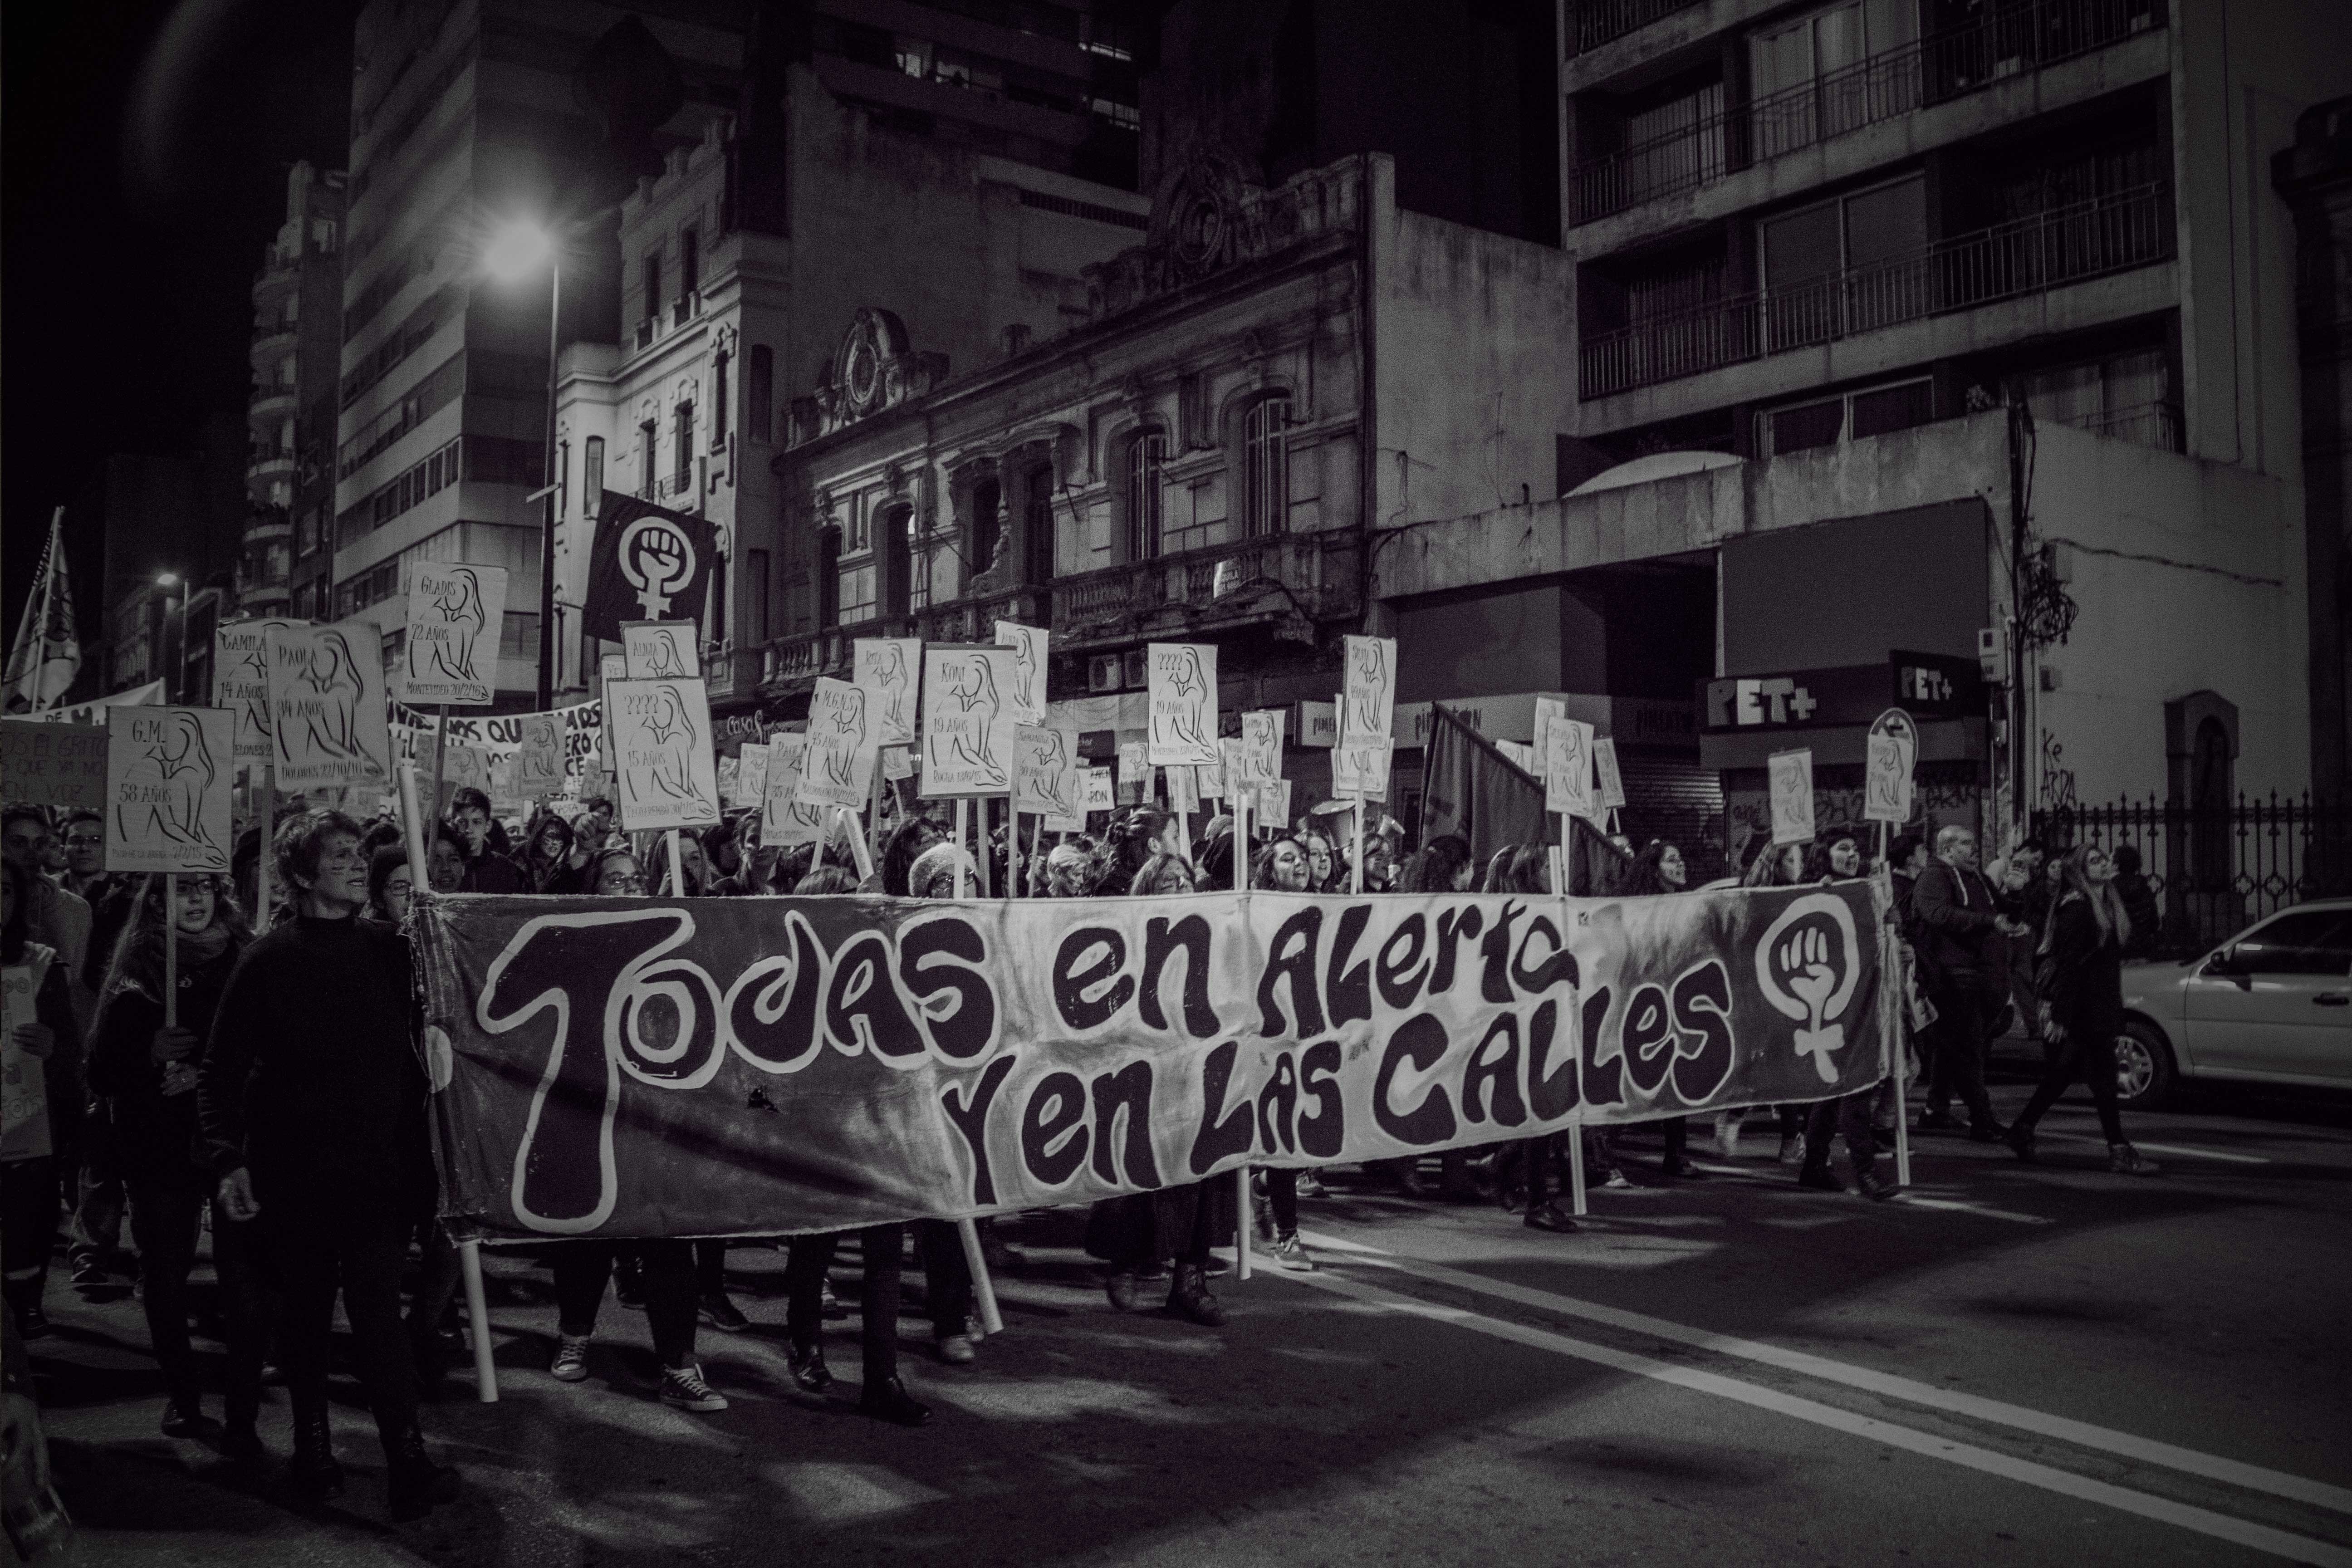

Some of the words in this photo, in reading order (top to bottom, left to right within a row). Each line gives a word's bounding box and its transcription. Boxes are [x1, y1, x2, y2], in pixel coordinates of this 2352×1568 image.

[421, 576, 456, 596] GLADIS
[412, 624, 423, 640] 72
[426, 626, 449, 641] AÑOS
[1158, 653, 1182, 670] ????
[236, 683, 264, 699] AÑOS
[407, 681, 449, 696] MONTEVIDEO
[624, 695, 658, 714] ????
[120, 783, 137, 802] 58
[141, 785, 172, 803] AÑOS
